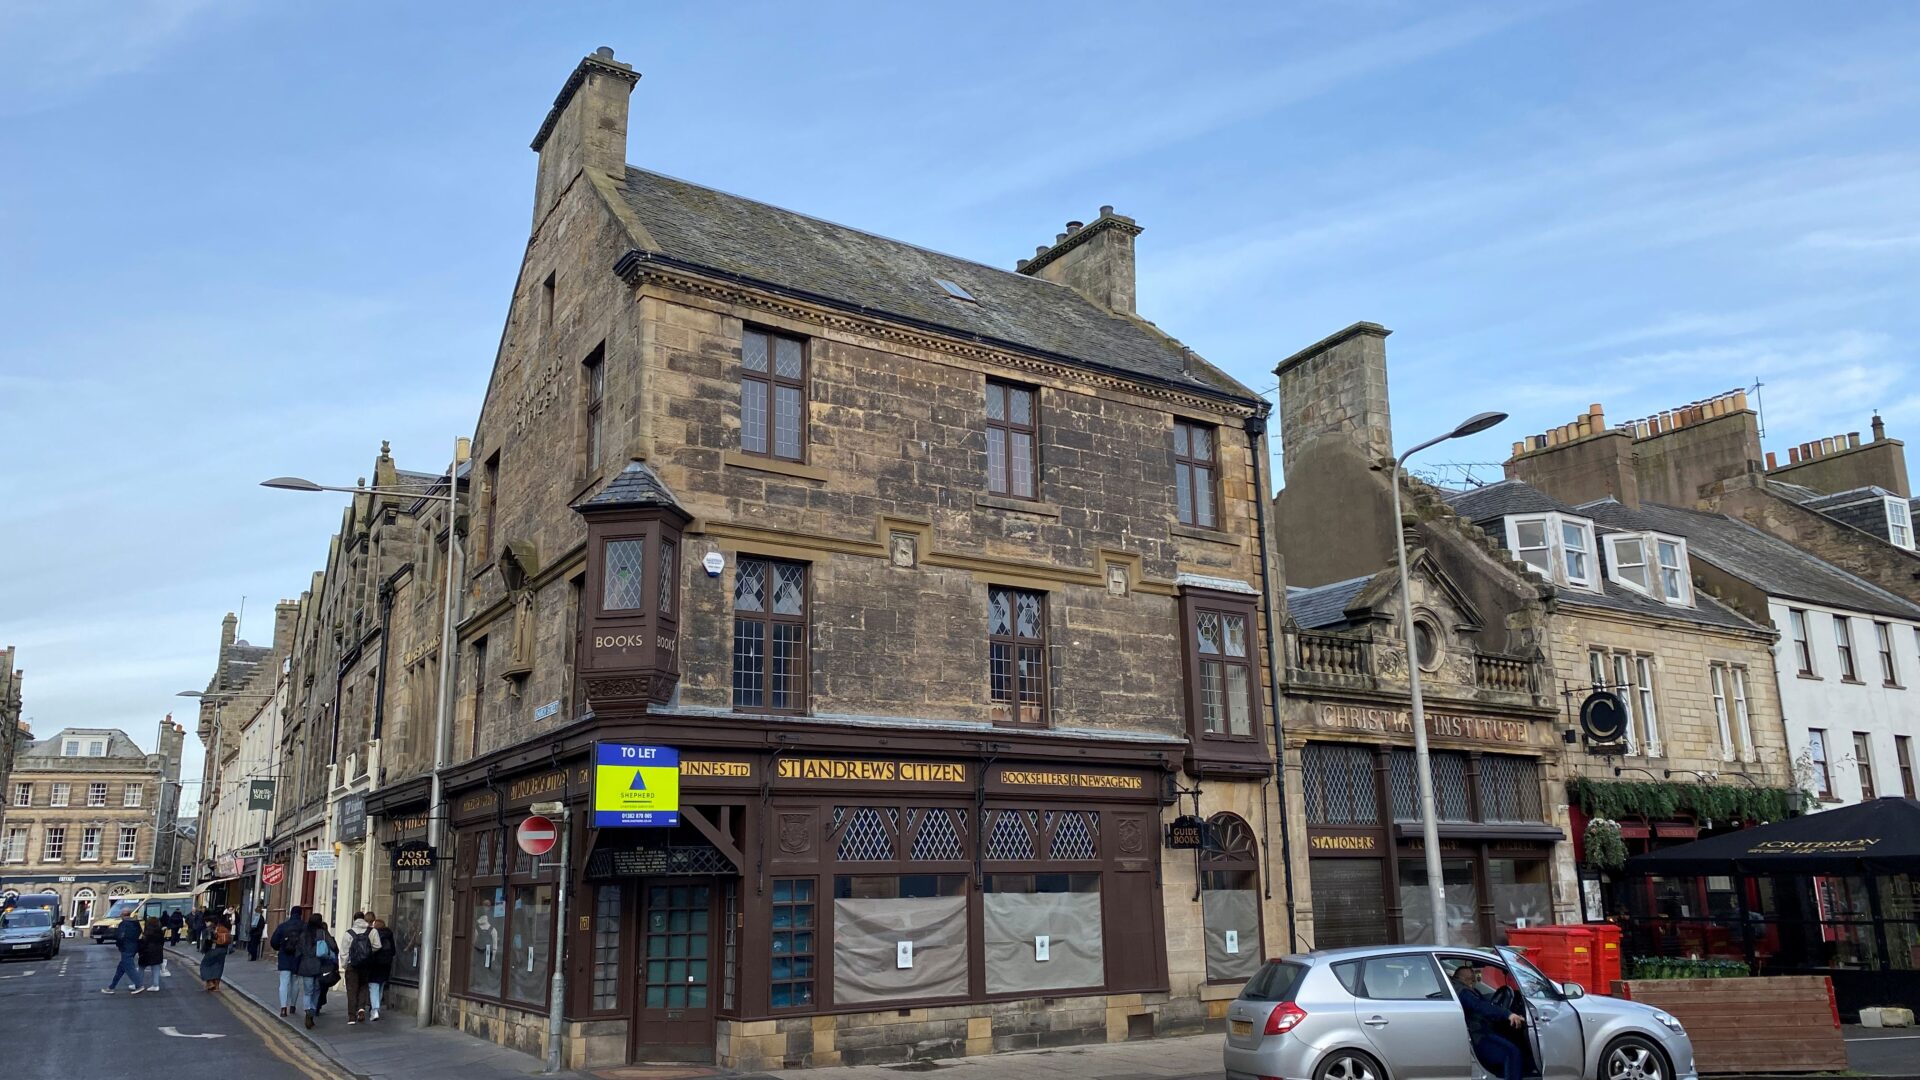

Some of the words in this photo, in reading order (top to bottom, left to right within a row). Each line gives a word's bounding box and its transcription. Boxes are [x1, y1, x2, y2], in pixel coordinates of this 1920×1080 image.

[596, 635, 643, 648] BOOKS
[657, 635, 675, 651] BOOKS
[1322, 705, 1414, 733] CHRISTIA
[1434, 715, 1528, 743] INSTITUTE
[1586, 698, 1618, 737] C
[621, 747, 636, 758] TO
[638, 747, 657, 759] LET
[686, 762, 726, 775] INNES
[728, 764, 749, 776] LTD
[778, 759, 800, 777] ST
[805, 760, 894, 779] ANDREWS
[900, 763, 965, 781] CITIZEN
[1002, 772, 1069, 785] BOOKSELLERS
[1071, 774, 1078, 786] &
[1080, 775, 1141, 788] NEWSAGENTS
[1173, 827, 1199, 836] GUIDE
[1174, 835, 1200, 844] BOOKS
[1311, 836, 1375, 849] STATIONERS
[401, 850, 430, 859] POST
[397, 858, 431, 866] CARDS
